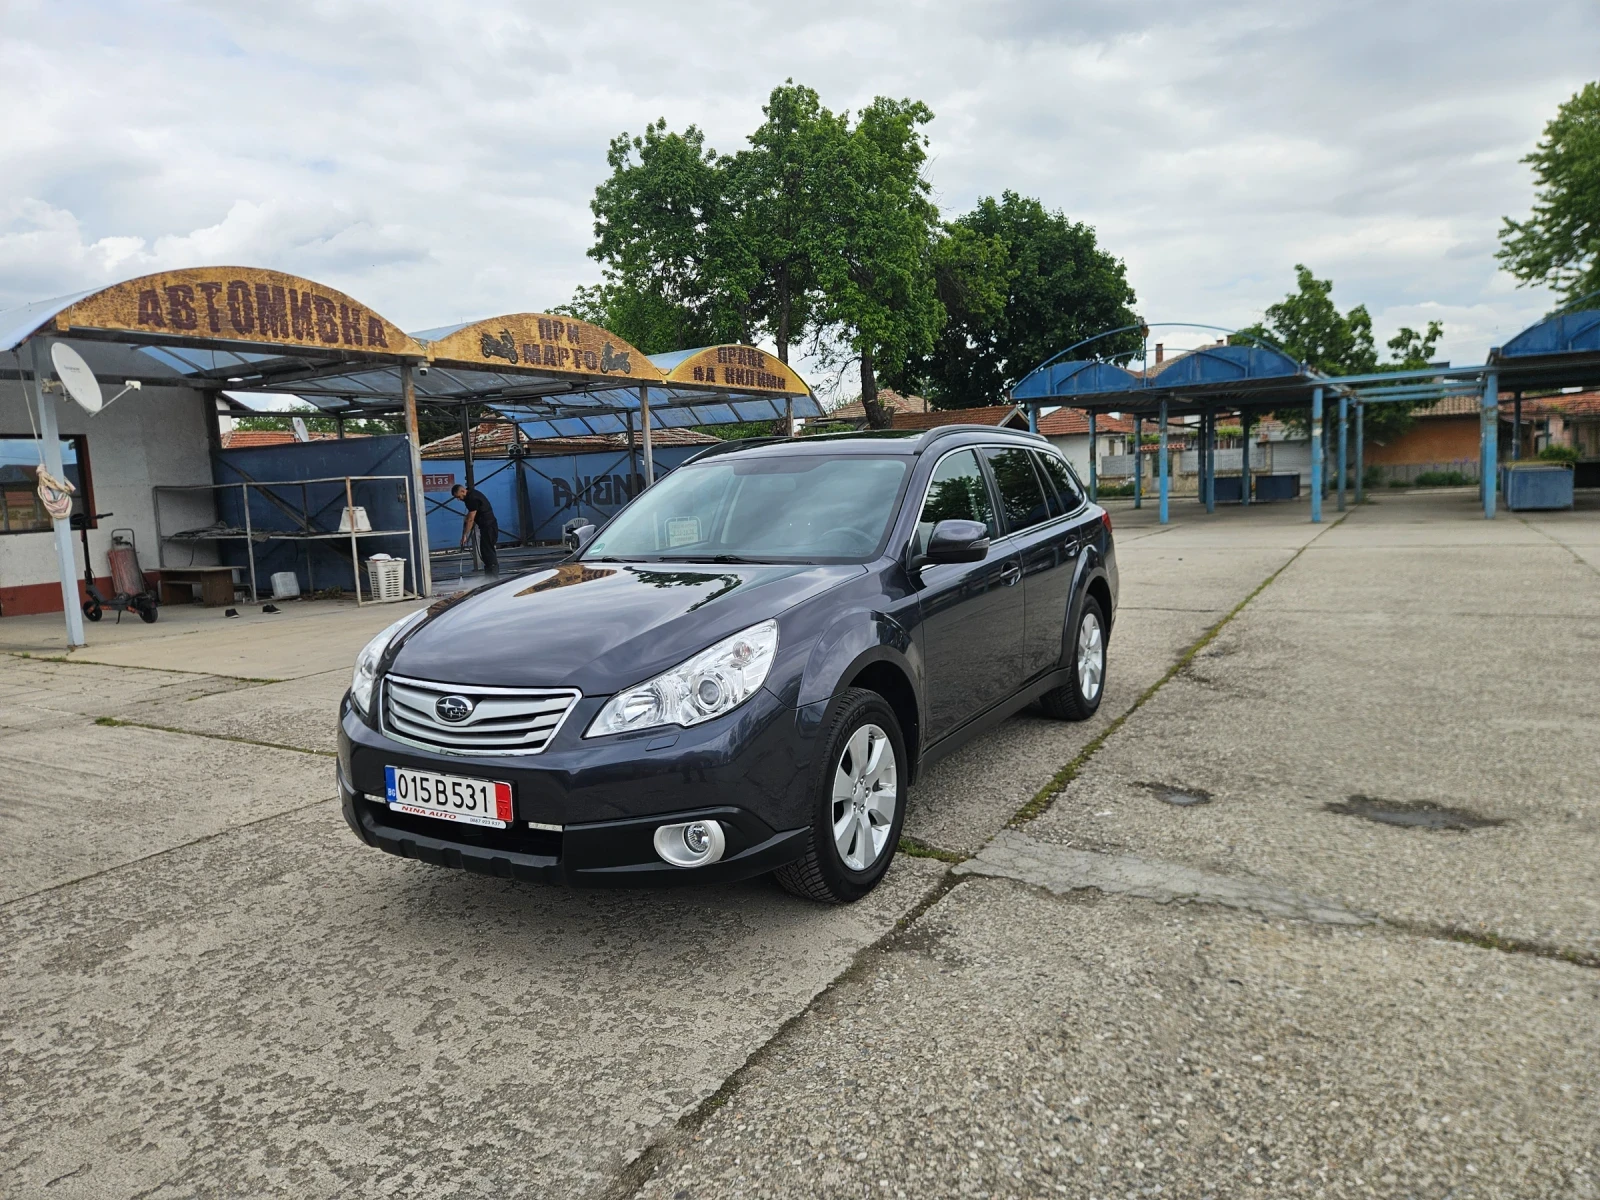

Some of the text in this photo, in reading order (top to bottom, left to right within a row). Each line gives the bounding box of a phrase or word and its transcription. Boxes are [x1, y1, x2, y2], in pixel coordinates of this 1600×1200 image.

[138, 280, 388, 348] АВТОМИВКА
[538, 318, 580, 344] ПРИ
[523, 344, 598, 370] МАРТО
[718, 346, 764, 368] ПРАНЕ
[387, 788, 396, 797] BG
[401, 805, 456, 820] NINA AUTO
